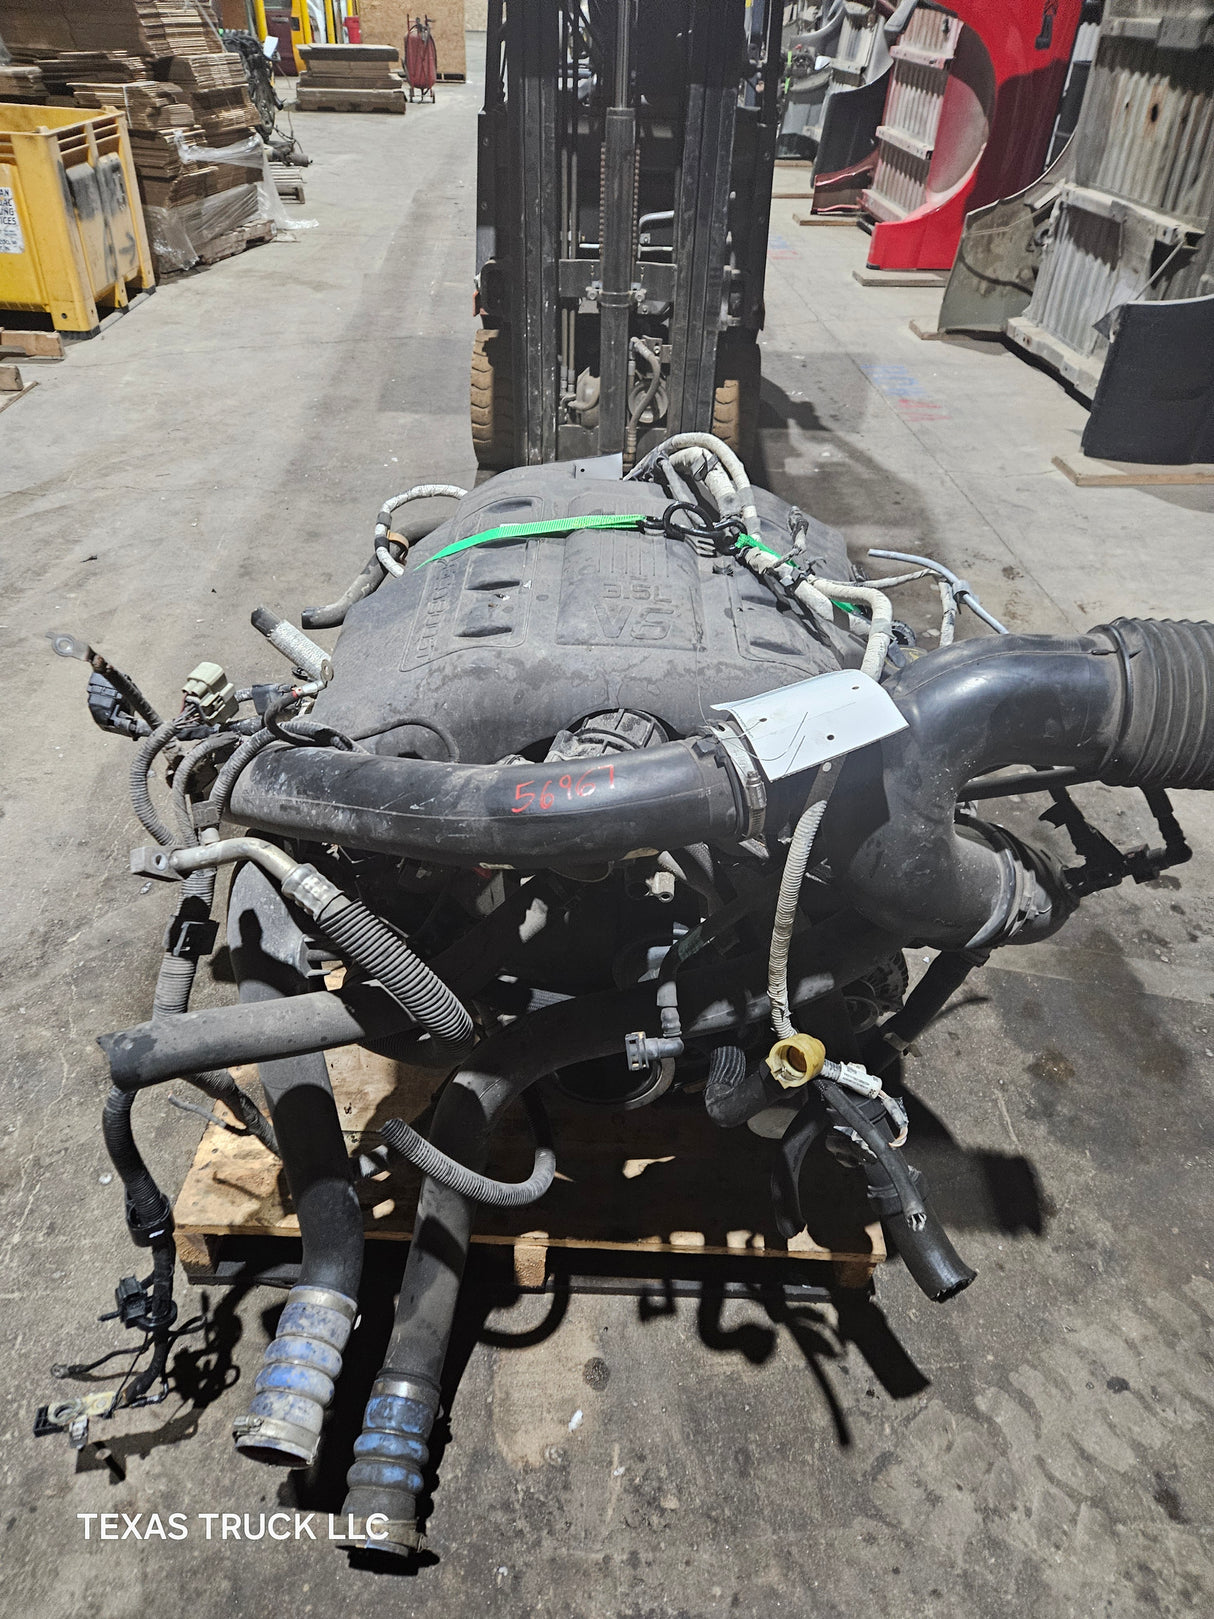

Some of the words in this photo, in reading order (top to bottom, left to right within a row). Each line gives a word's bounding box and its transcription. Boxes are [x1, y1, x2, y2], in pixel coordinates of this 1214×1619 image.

[602, 582, 673, 604] 3.5L
[594, 603, 675, 641] V6
[511, 764, 615, 813] 56967
